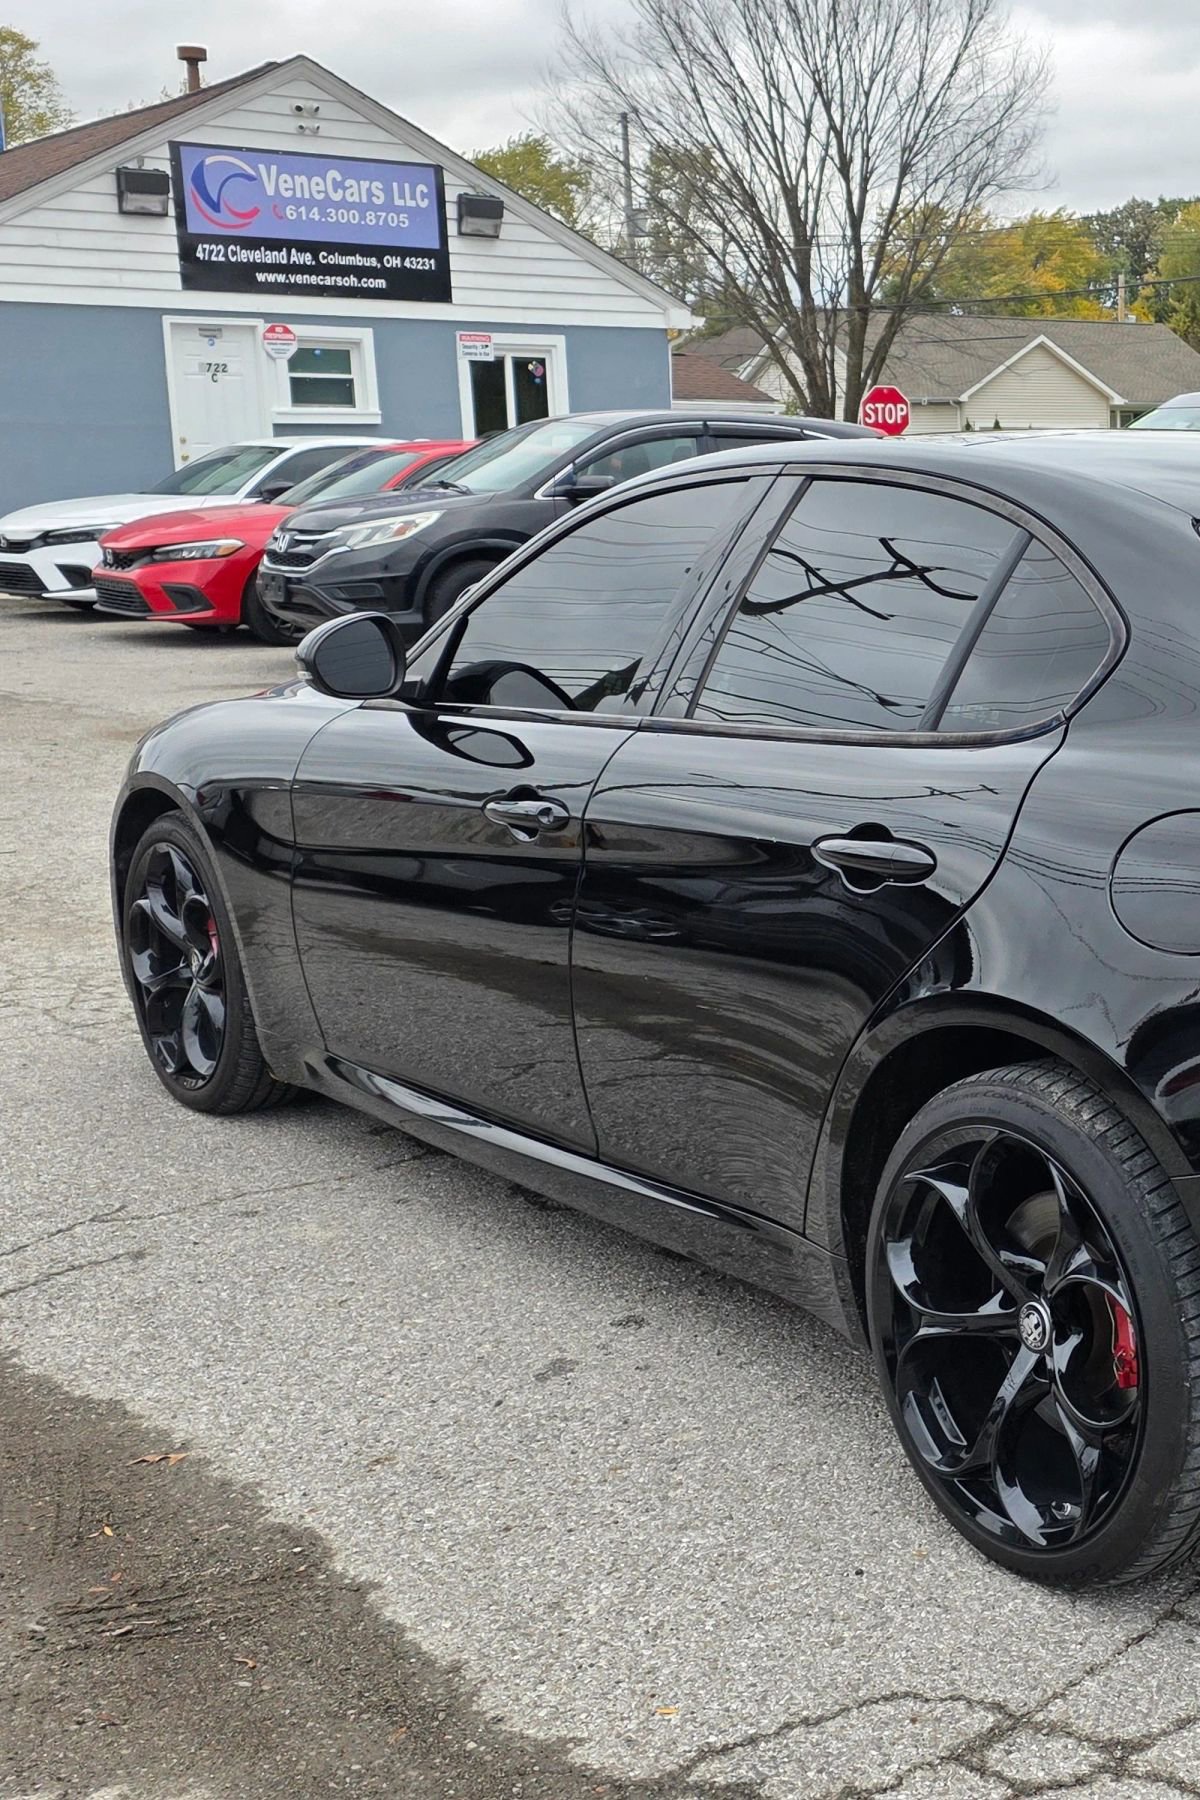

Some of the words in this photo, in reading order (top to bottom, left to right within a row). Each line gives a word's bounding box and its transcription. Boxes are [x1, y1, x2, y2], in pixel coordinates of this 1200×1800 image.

[257, 163, 385, 205] VeneCars
[393, 181, 429, 208] LLC
[285, 204, 409, 228] 614.300.8705
[196, 243, 225, 262] 4722
[228, 244, 287, 265] Cleveland
[290, 248, 316, 266] Ave.
[319, 252, 381, 269] Columbus,
[383, 255, 400, 268] OH
[403, 257, 436, 270] 43231
[256, 271, 386, 289] www.venecarsoh.com
[865, 403, 907, 424] STOP
